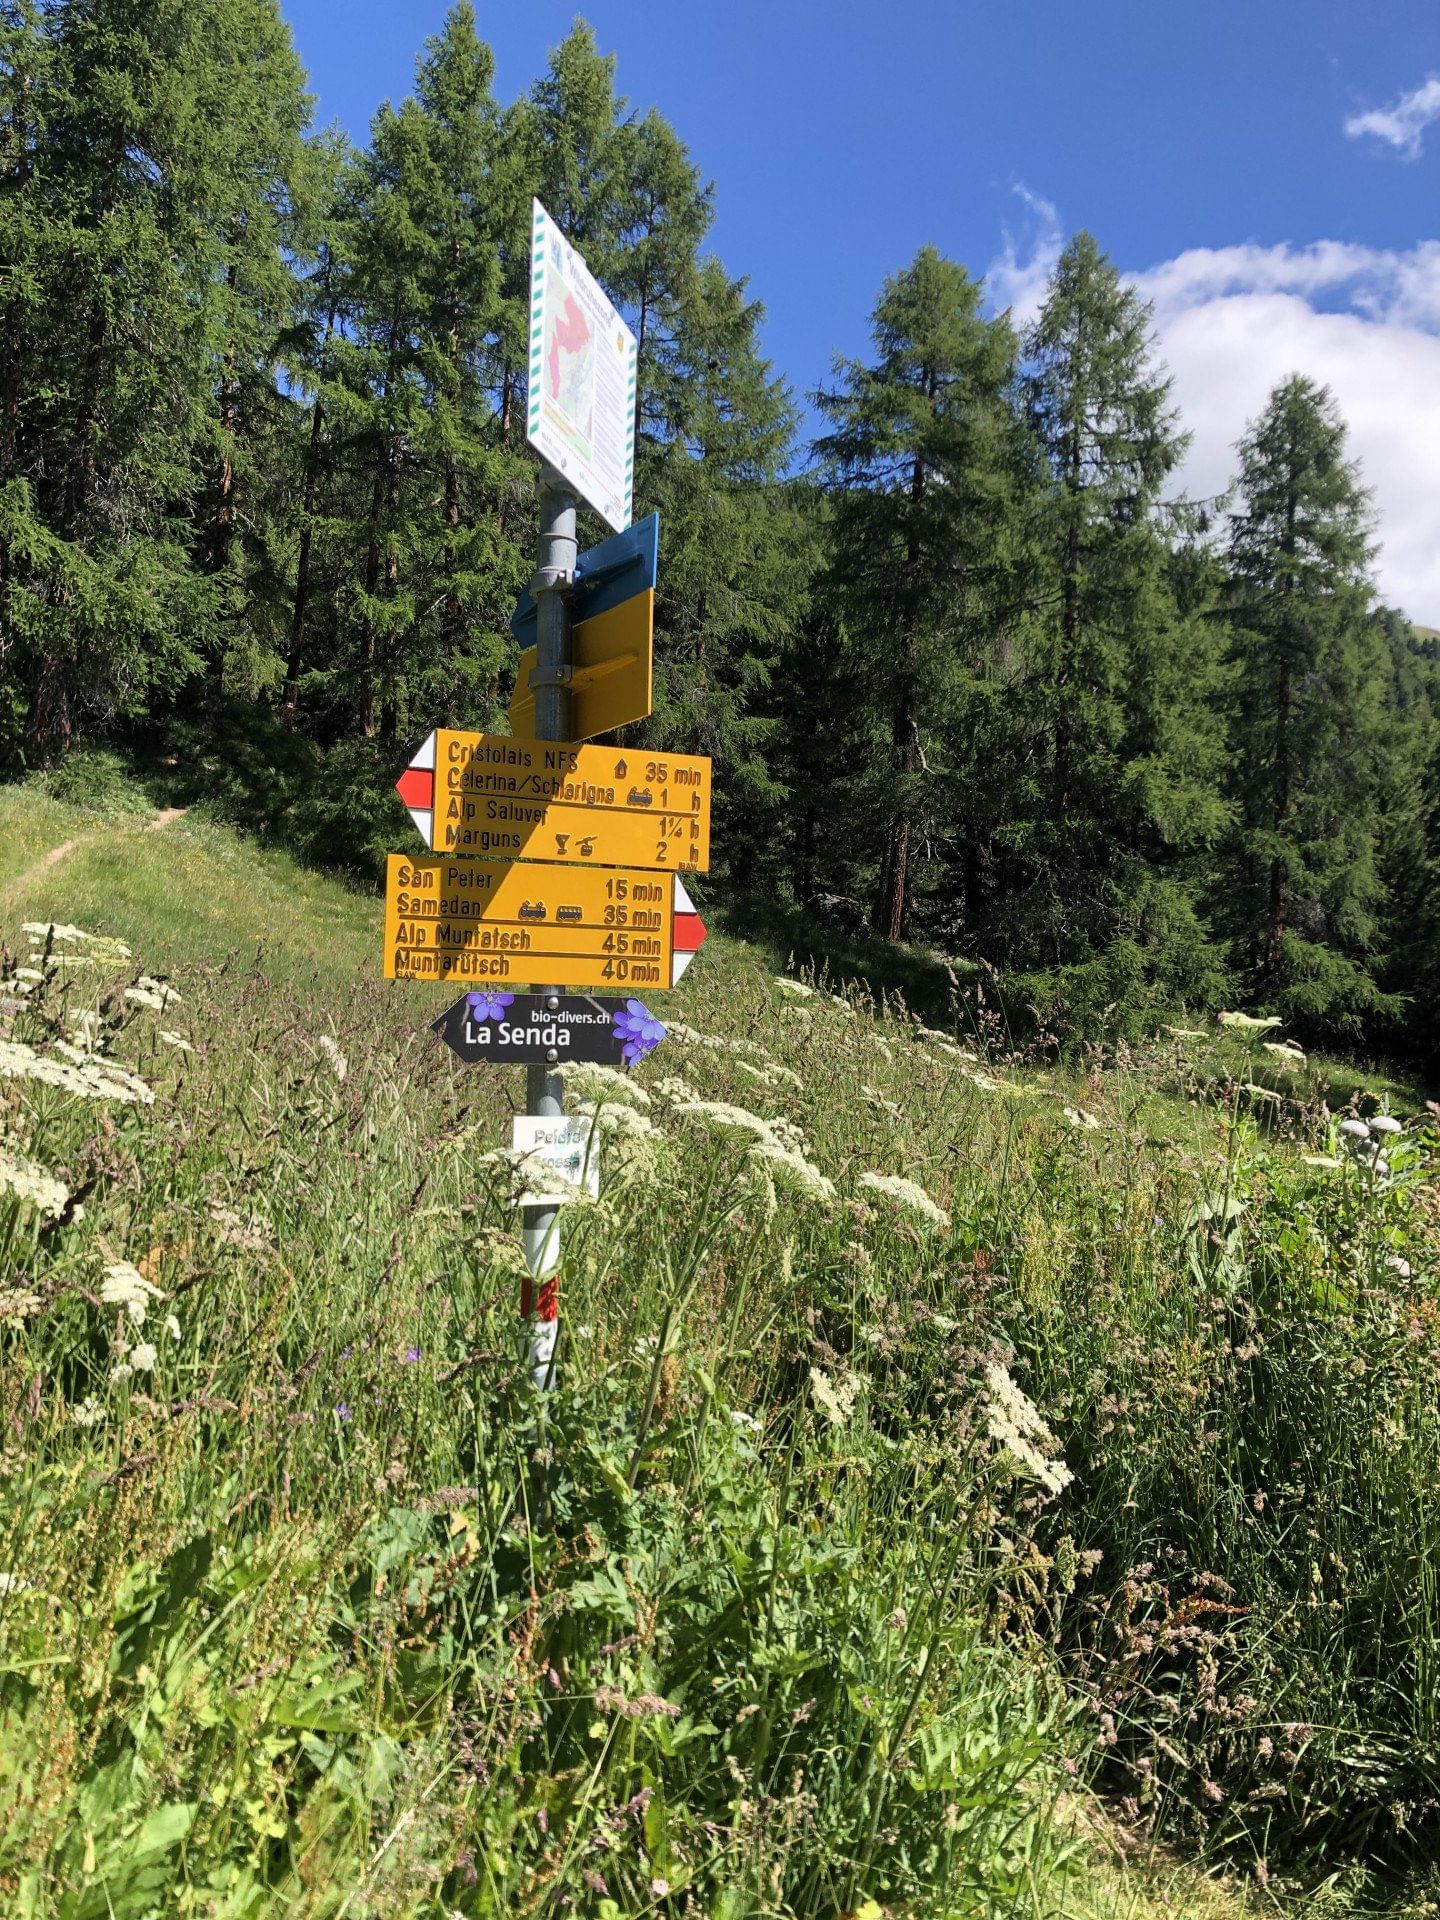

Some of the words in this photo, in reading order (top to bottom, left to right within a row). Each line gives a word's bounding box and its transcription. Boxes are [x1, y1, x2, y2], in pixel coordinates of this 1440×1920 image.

[448, 741, 532, 767] Cristolais
[545, 750, 578, 774] NFS
[645, 762, 668, 784] 35
[674, 767, 702, 786] min
[447, 767, 615, 805] Celerina/Schlarigna
[660, 788, 667, 808] 1
[692, 791, 700, 811] h
[447, 797, 475, 822] Alp
[487, 800, 548, 826] Saluver
[690, 818, 699, 839] h
[446, 824, 521, 850] Marguns
[656, 841, 667, 862] 2
[689, 843, 699, 862] h
[397, 865, 433, 888] San
[448, 867, 493, 888] Peter
[605, 878, 628, 900] 15
[633, 883, 663, 901] min
[397, 892, 480, 915] Samedan
[604, 905, 628, 925] 35
[632, 908, 661, 927] min
[395, 922, 426, 947] Alp
[436, 923, 531, 949] Muntatsch
[602, 932, 629, 953] 45
[632, 936, 661, 955] min
[395, 949, 510, 976] Muntarütsch
[601, 959, 629, 980] 40
[631, 962, 660, 982] min
[465, 1021, 491, 1044] La
[498, 1022, 571, 1046] Senda
[531, 1010, 611, 1024] bio-divers.ch
